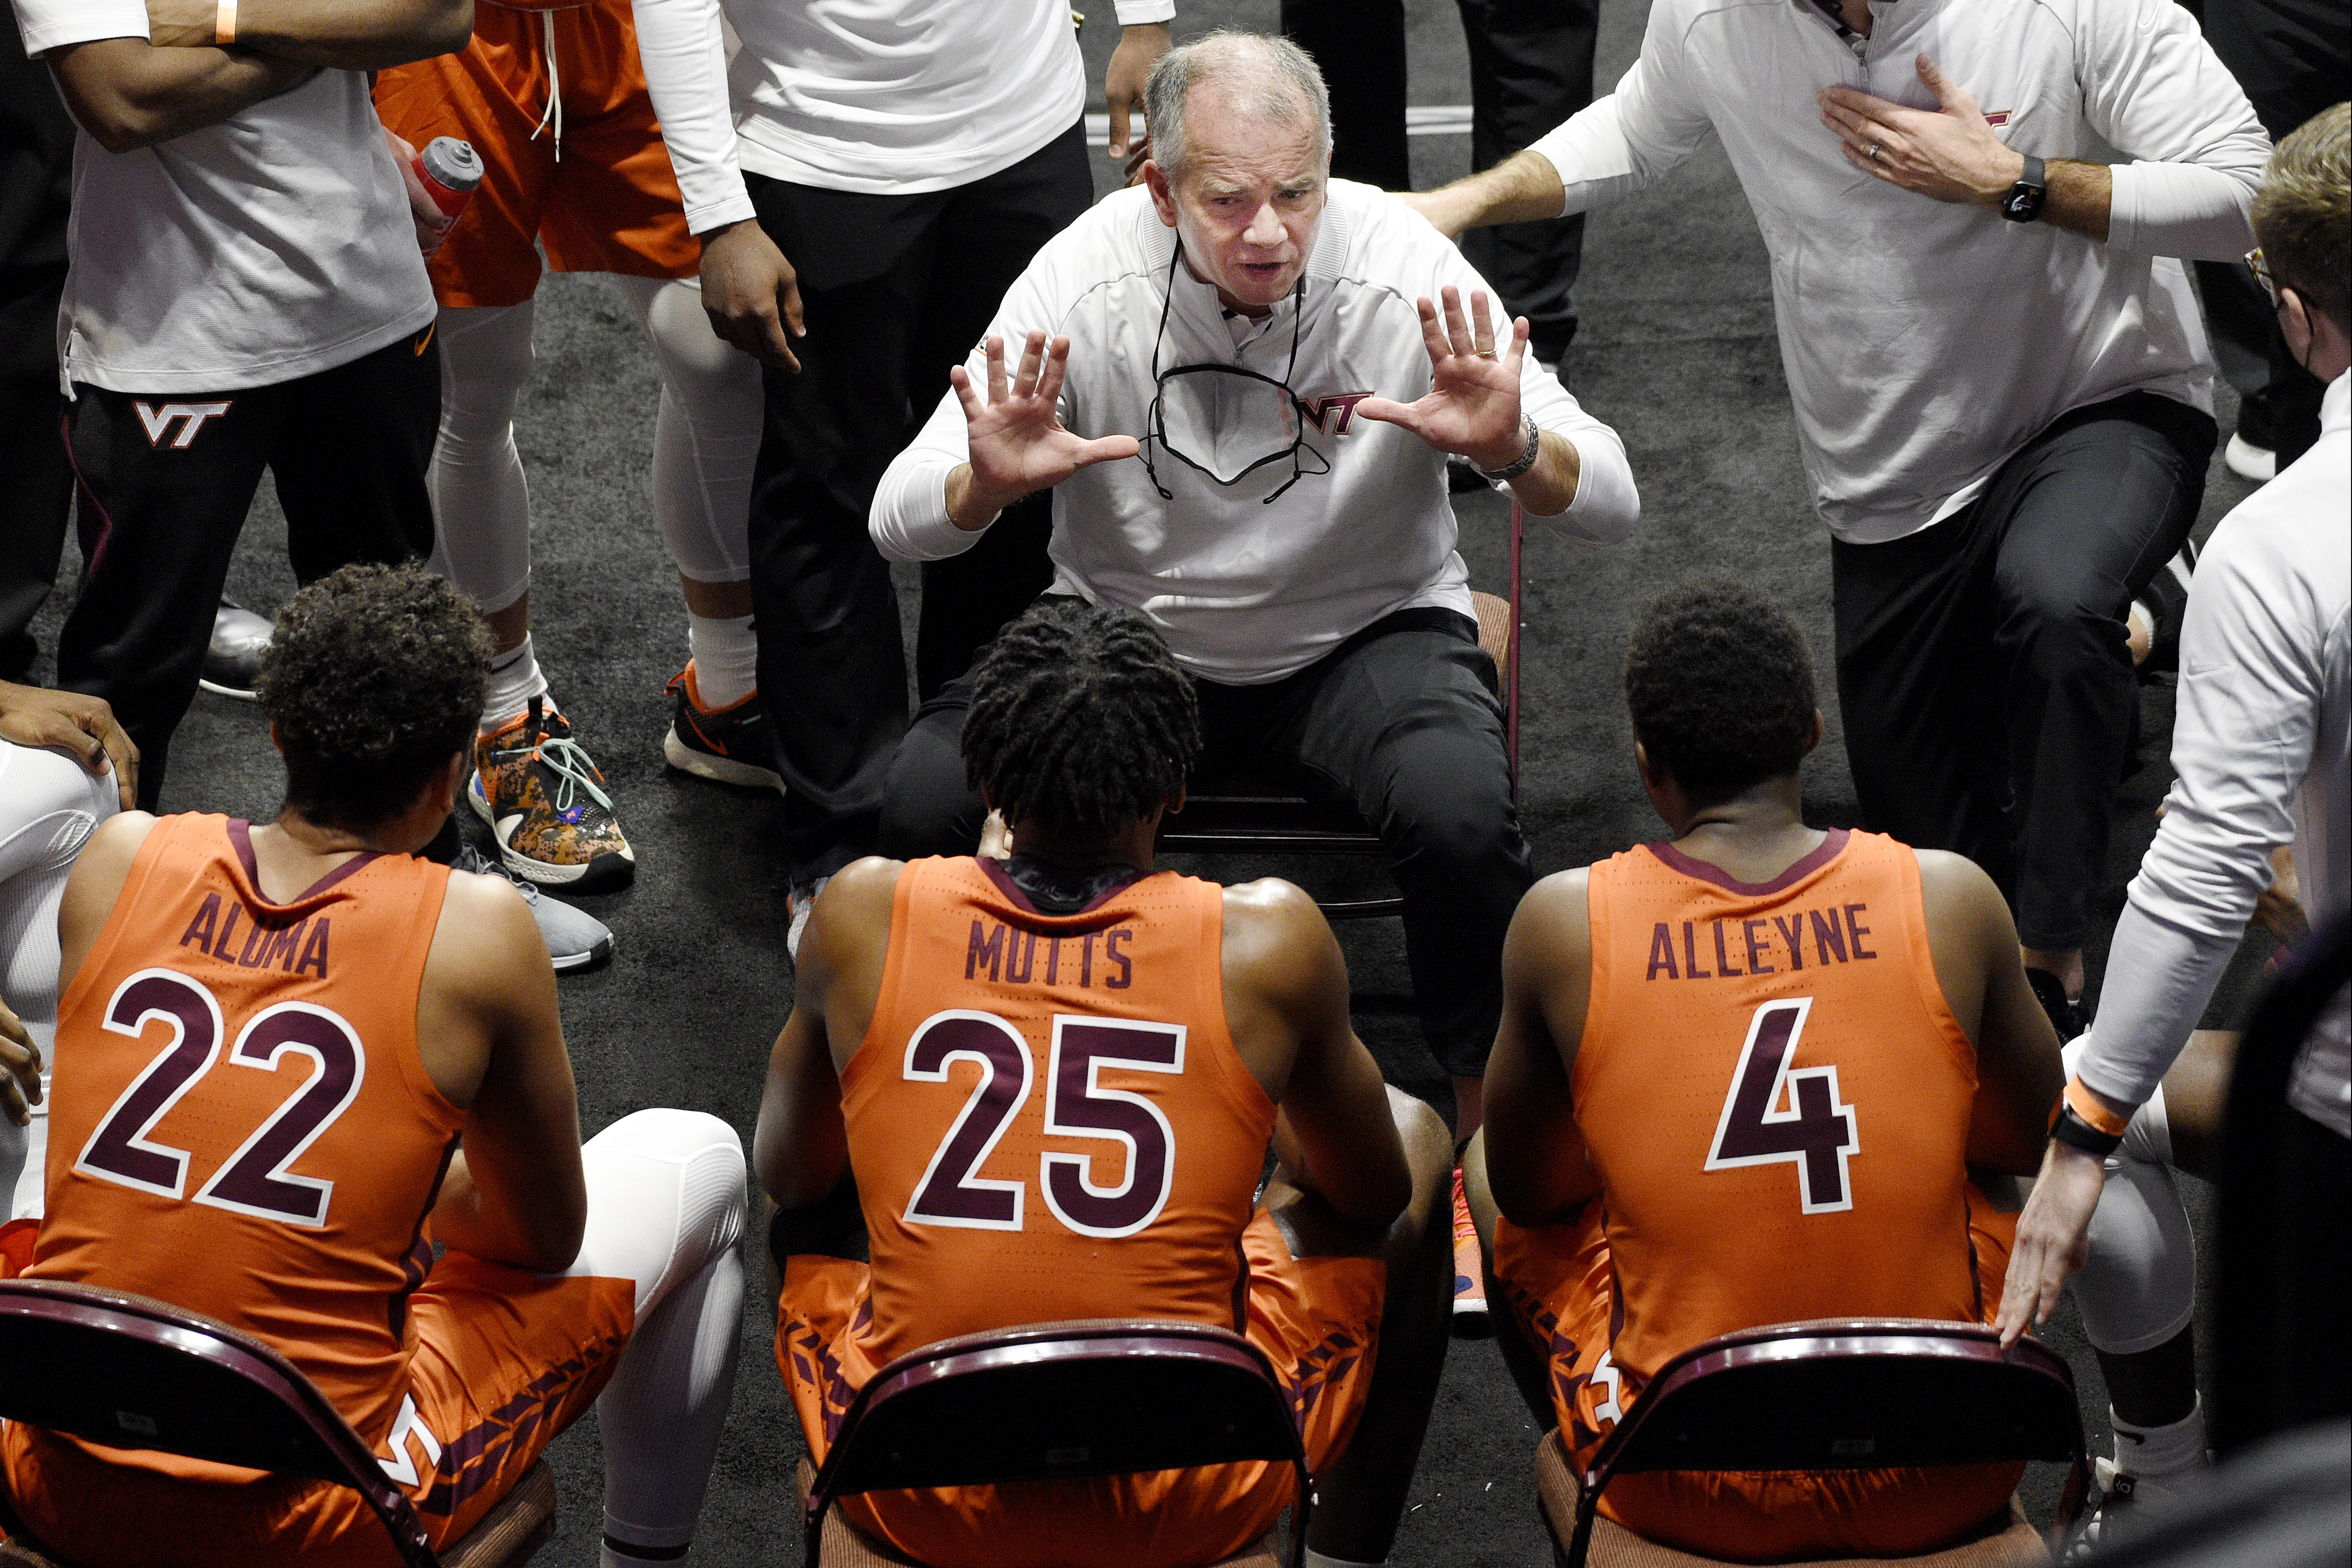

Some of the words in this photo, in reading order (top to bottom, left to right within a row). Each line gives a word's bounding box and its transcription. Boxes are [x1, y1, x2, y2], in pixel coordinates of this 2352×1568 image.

[132, 399, 233, 449] VT
[1298, 392, 1375, 435] VT
[179, 892, 329, 978] ALOMA
[965, 919, 1132, 989] MUTTS
[1646, 904, 1876, 980] ALLEYNE
[74, 967, 365, 1227] 22
[902, 1008, 1187, 1238] 25
[1704, 997, 1860, 1214] 4
